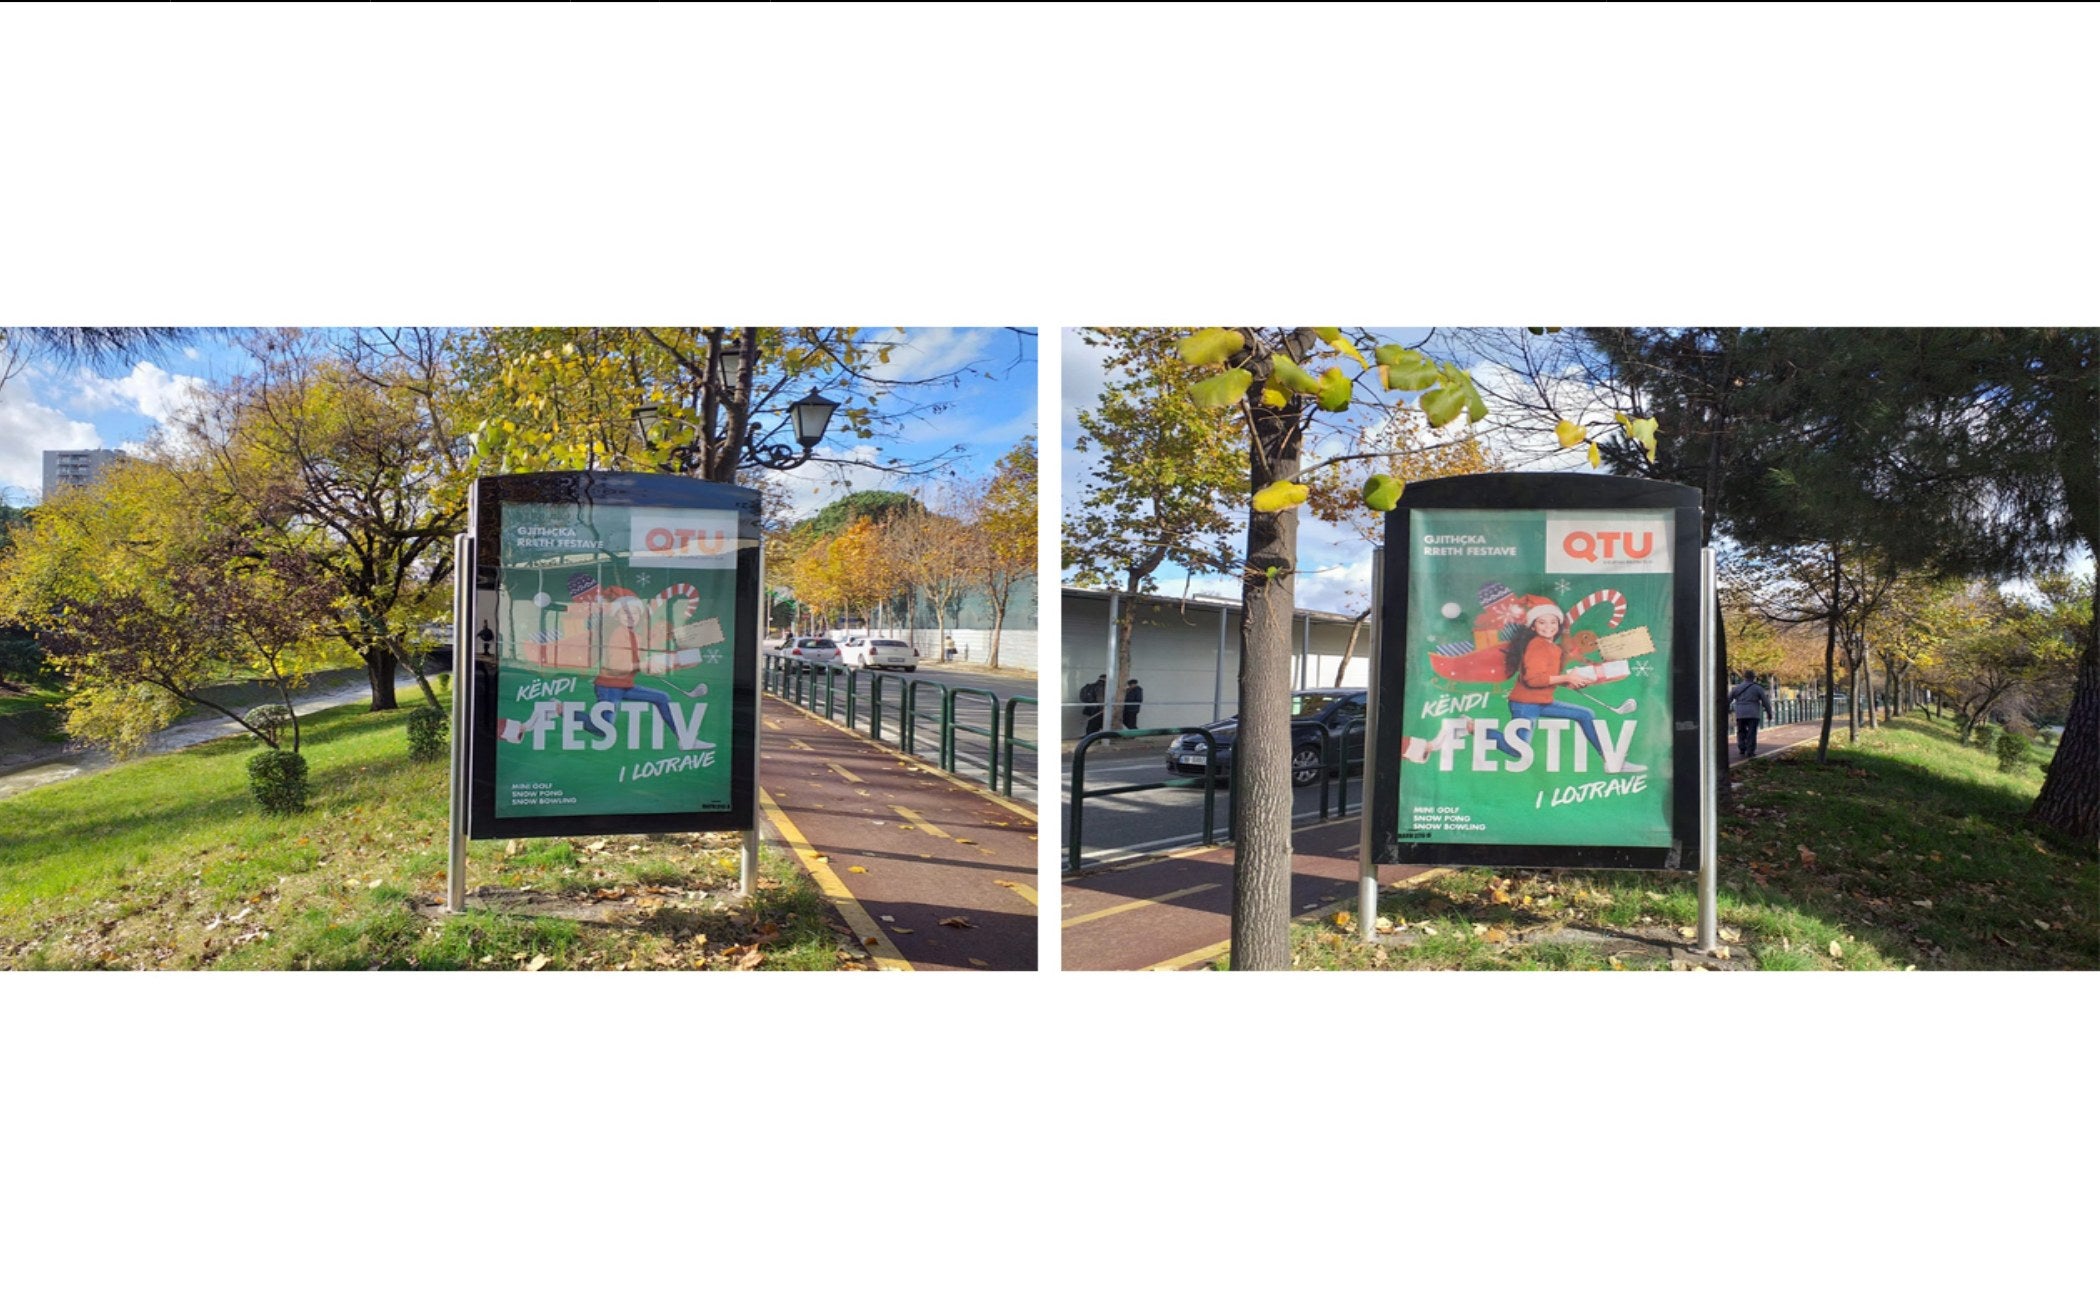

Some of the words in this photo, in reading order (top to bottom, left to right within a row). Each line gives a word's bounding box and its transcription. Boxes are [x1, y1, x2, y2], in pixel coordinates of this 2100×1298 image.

[558, 540, 604, 549] FESTAVE
[646, 527, 724, 558] QTU
[1424, 534, 1486, 546] GJITHÇKA
[1424, 547, 1463, 556] RRETH
[1467, 547, 1517, 556] FESTAVE
[1563, 531, 1653, 563] QTU
[516, 676, 576, 701] KËNDI
[1421, 691, 1489, 719] KËNDI
[532, 701, 708, 751] FESTIV
[1439, 718, 1638, 773] FESTIV
[619, 766, 626, 782] I
[632, 751, 716, 781] LOJRAVE
[1535, 791, 1544, 809] I
[1551, 774, 1648, 807] LOJRAVE
[1444, 823, 1486, 831] BOWLING
